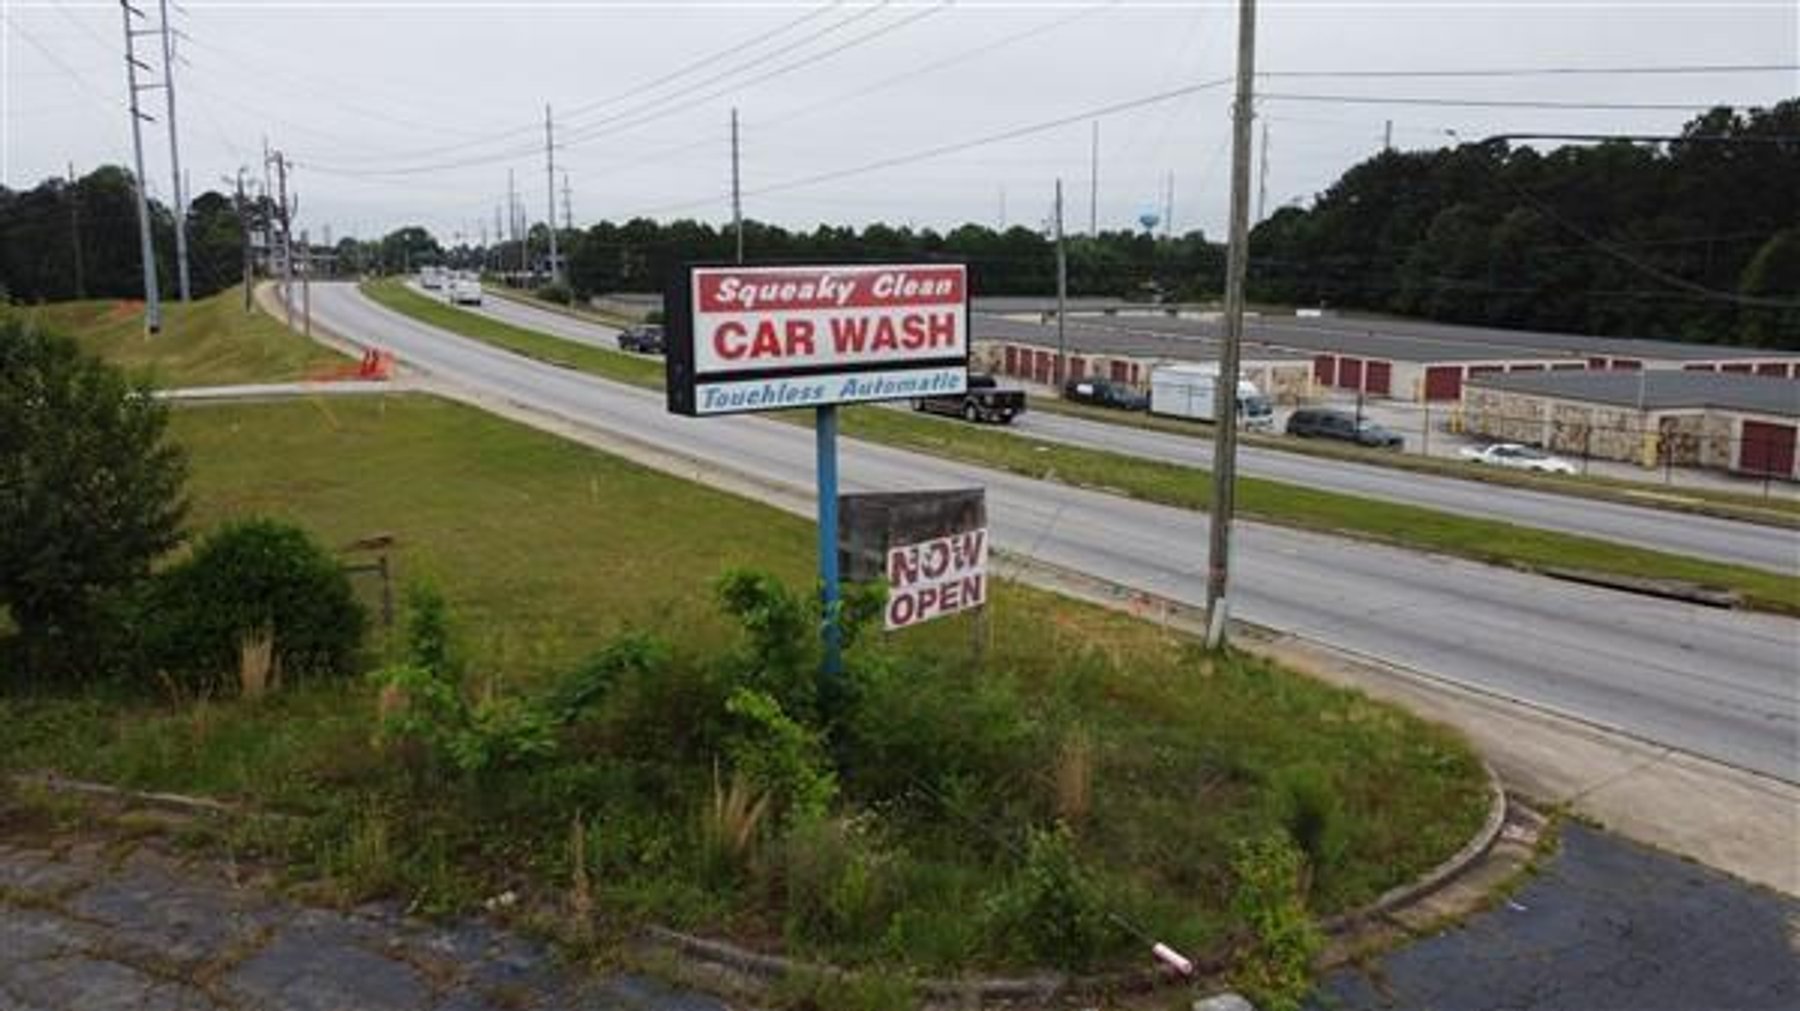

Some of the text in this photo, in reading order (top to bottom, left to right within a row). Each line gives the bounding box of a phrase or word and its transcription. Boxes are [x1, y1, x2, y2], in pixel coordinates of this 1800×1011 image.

[715, 273, 953, 306] Squeaky Clean
[713, 312, 956, 360] CAR WASH
[702, 371, 962, 409] Touchless Automatic
[891, 531, 984, 588] NOW
[890, 573, 981, 625] OPEN
